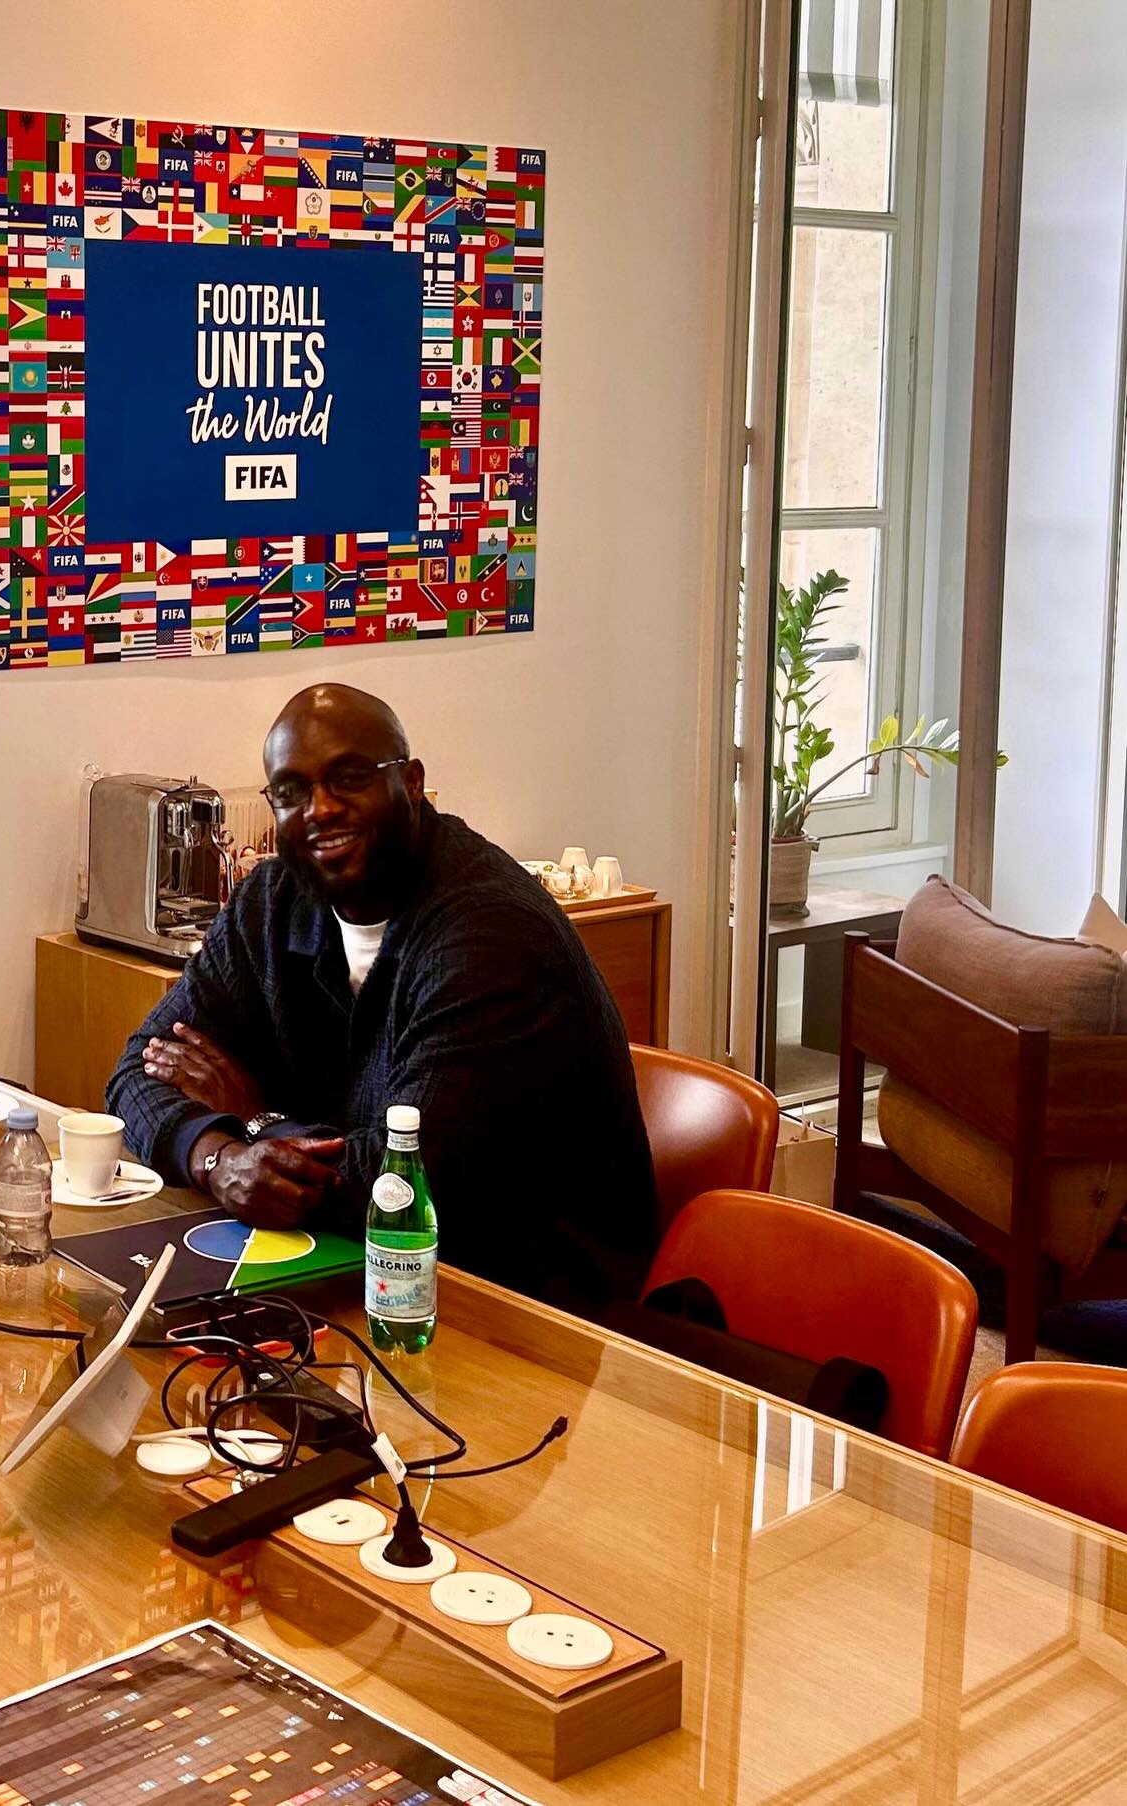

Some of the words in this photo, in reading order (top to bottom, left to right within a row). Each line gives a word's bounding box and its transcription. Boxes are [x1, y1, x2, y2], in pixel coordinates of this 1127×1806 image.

[164, 158, 189, 173] FIFA
[521, 153, 542, 165] FIFA
[335, 169, 358, 182] FIFA
[52, 215, 79, 228] FIFA
[429, 233, 450, 245] FIFA
[197, 283, 326, 327] FOOTBALL
[197, 330, 325, 389] UNITES
[185, 391, 240, 444] the
[244, 389, 333, 445] World
[235, 465, 288, 489] FIFA
[423, 538, 444, 550] FIFA
[53, 554, 79, 567] FIFA
[329, 598, 351, 610] FIFA
[161, 608, 186, 620] FIFA
[509, 613, 530, 625] FIFA
[230, 633, 255, 646] FIFA
[367, 1254, 422, 1272] ELLEGRINO
